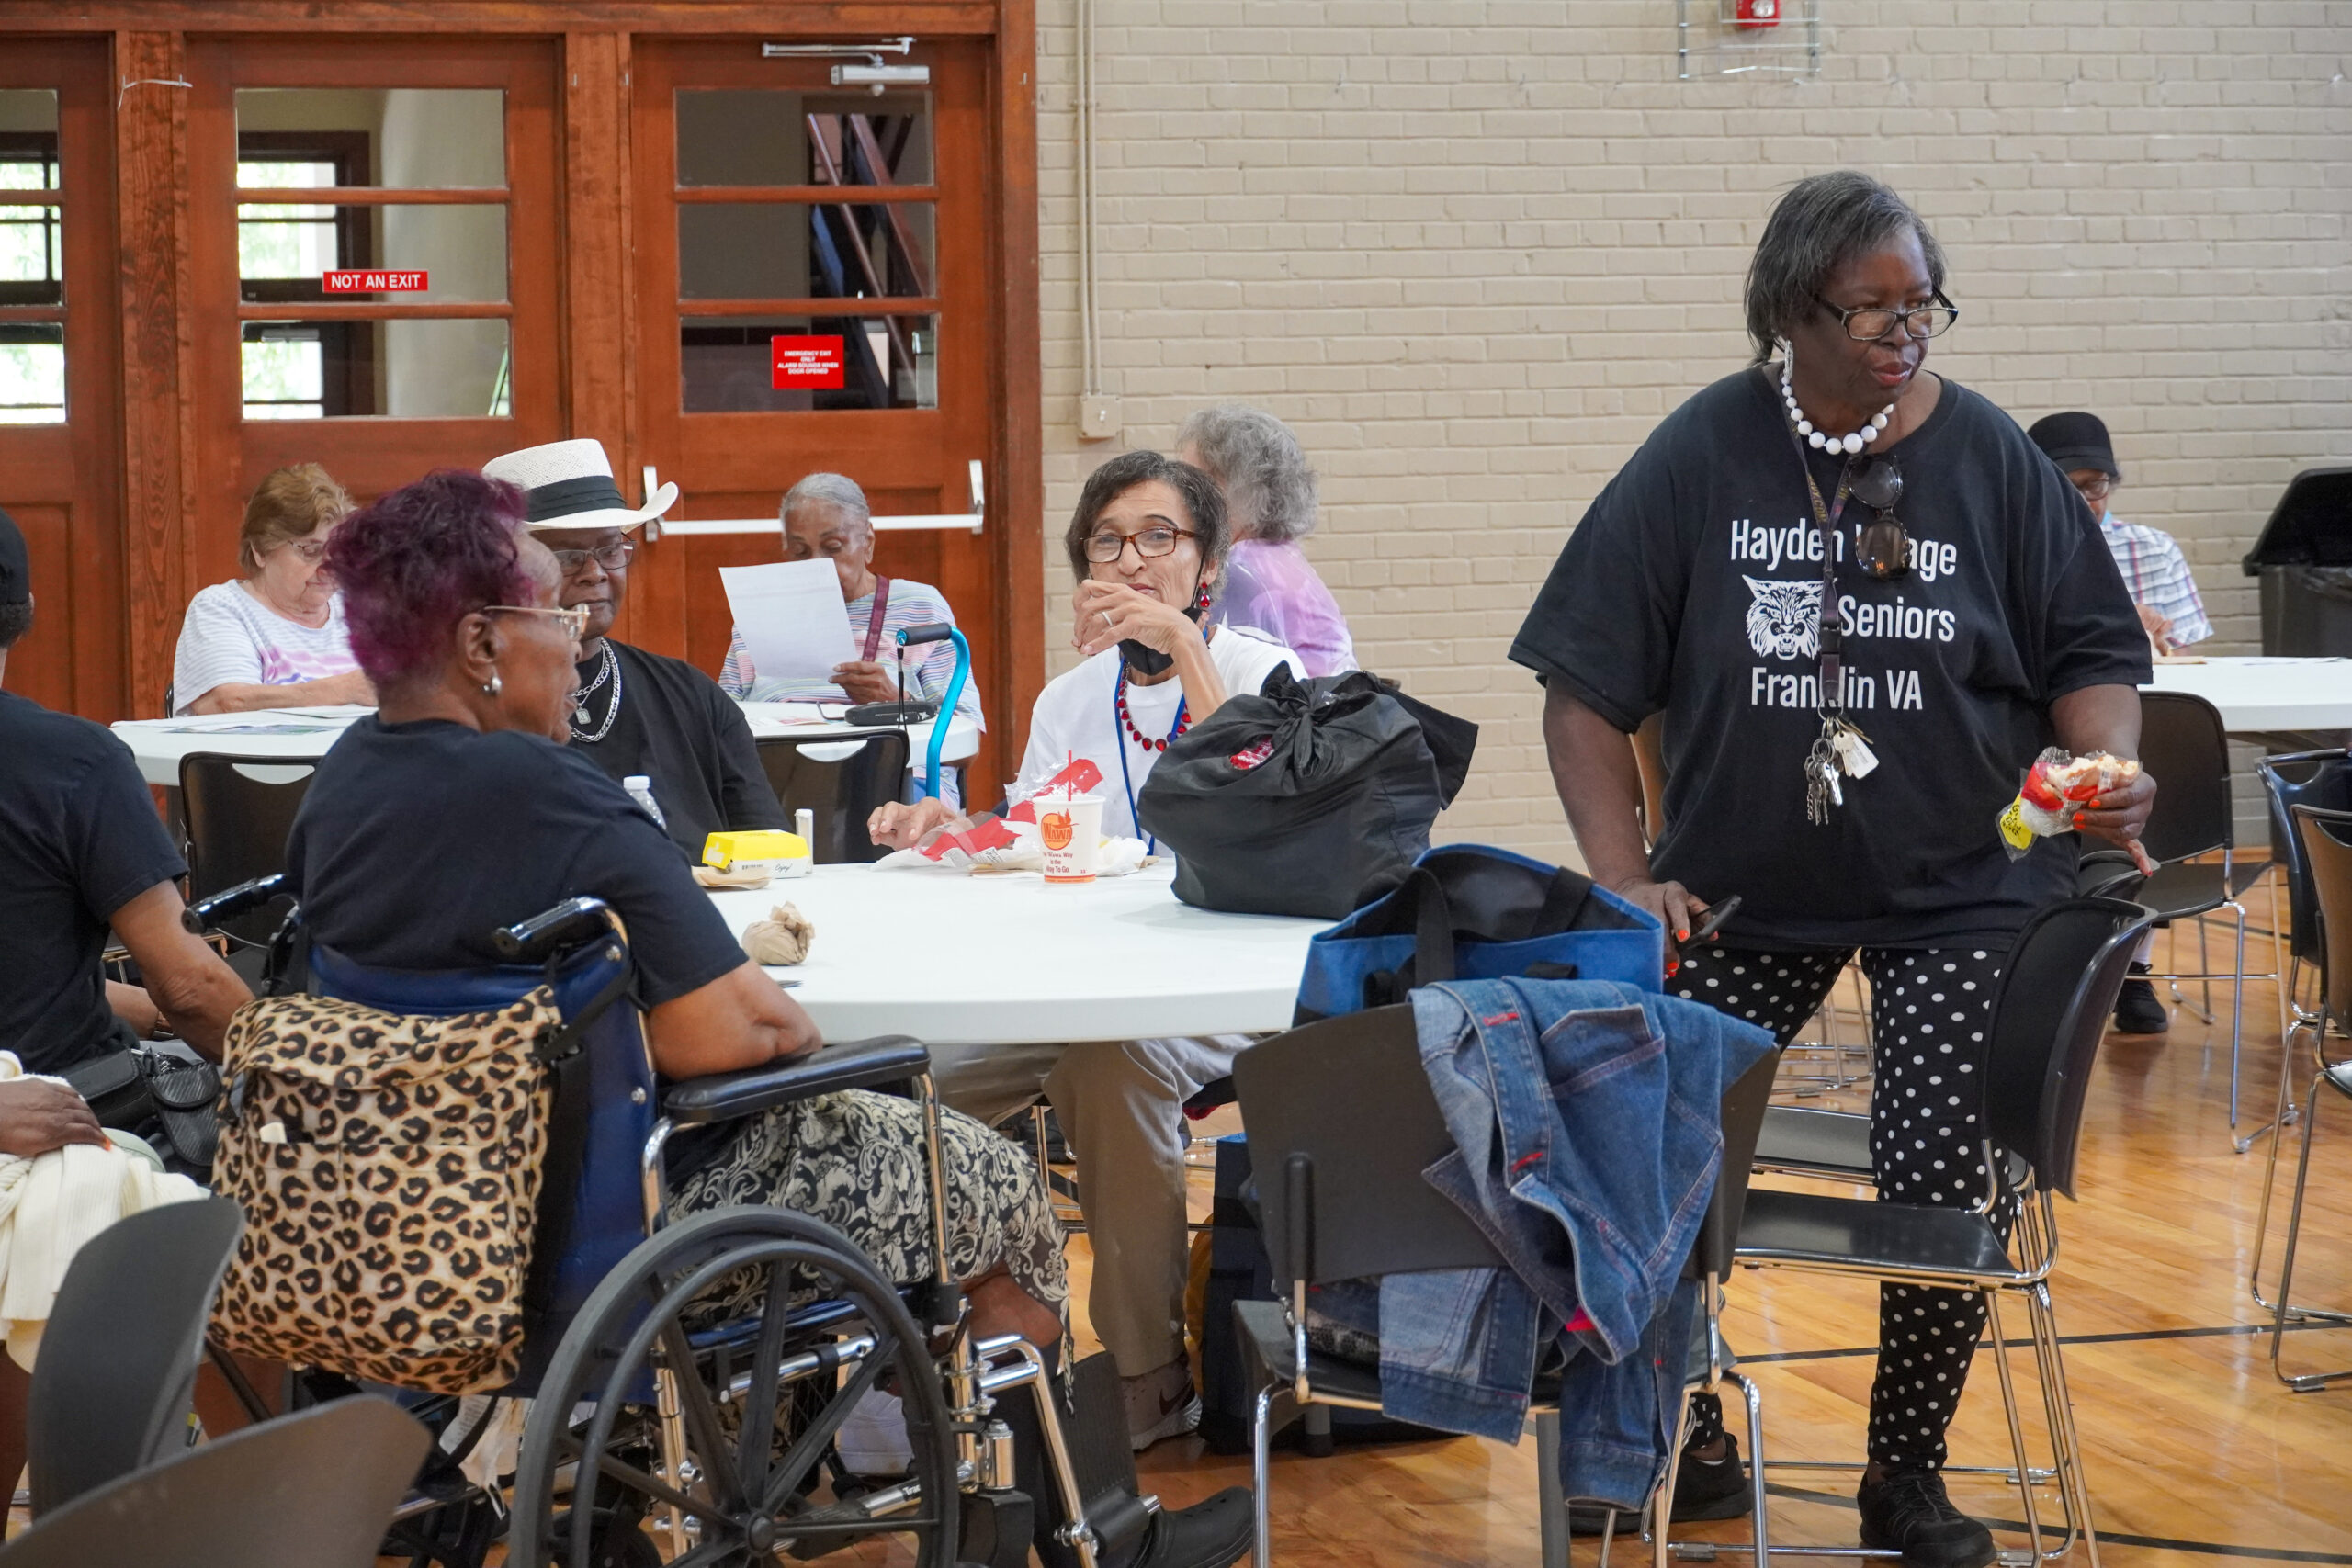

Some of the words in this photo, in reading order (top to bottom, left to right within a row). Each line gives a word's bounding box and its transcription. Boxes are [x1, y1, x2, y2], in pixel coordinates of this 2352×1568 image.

[331, 274, 361, 288] NOT
[366, 274, 386, 288] AN
[389, 274, 421, 288] EXIT
[1730, 517, 1844, 571] Hayden
[1838, 595, 1956, 643] Seniors
[1751, 666, 1875, 710] Franlin
[1886, 669, 1923, 711] VA
